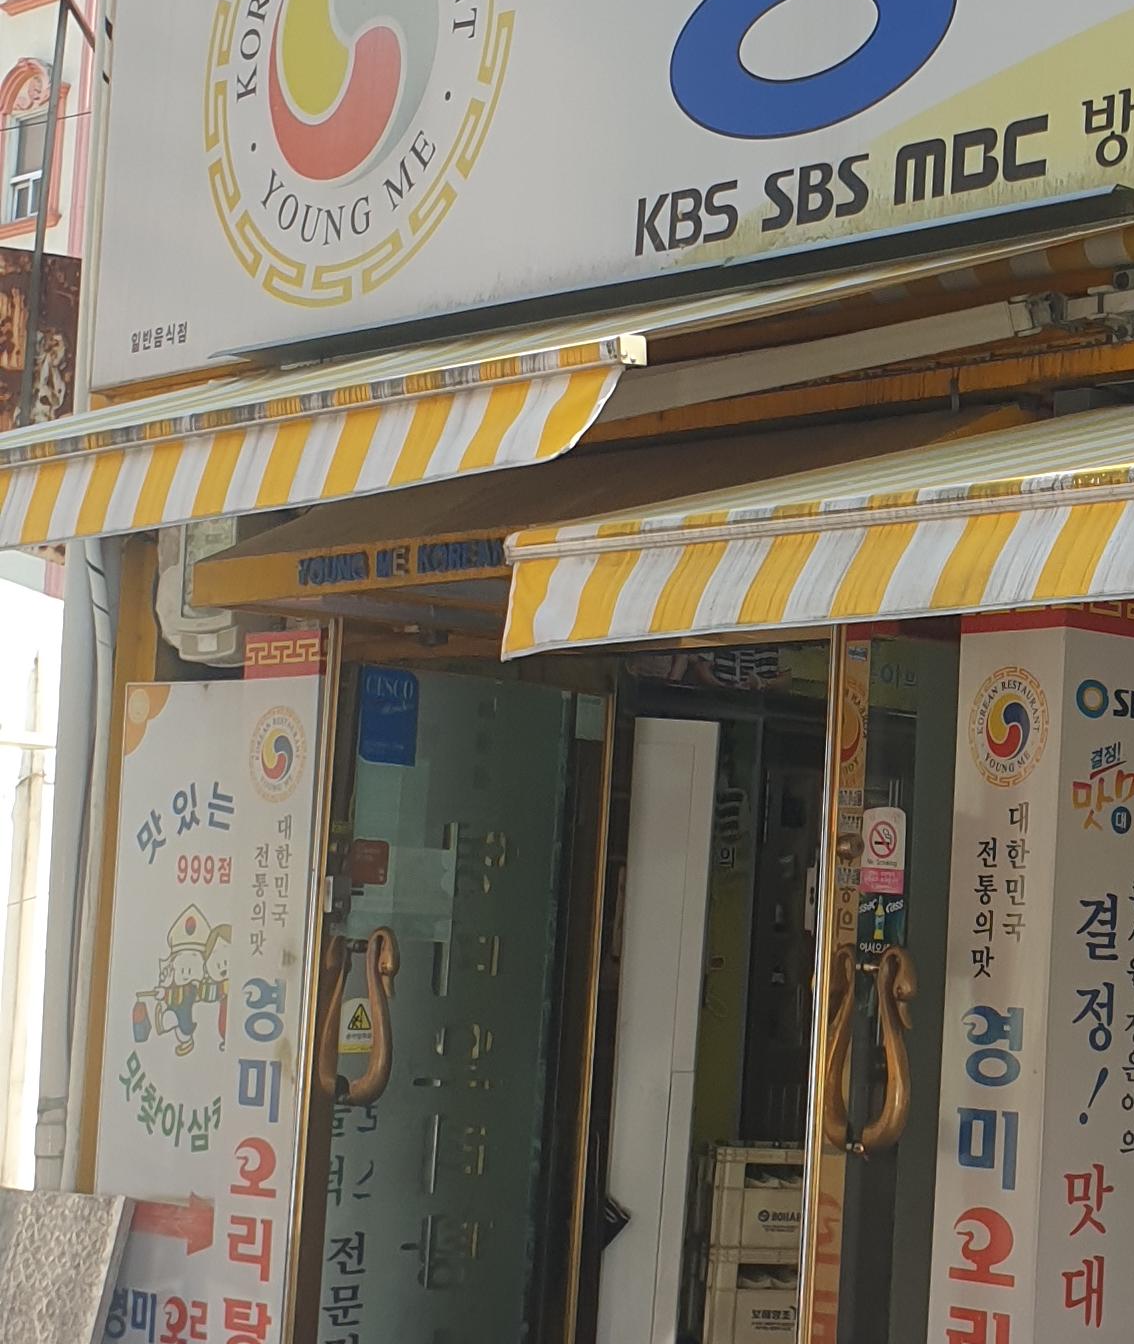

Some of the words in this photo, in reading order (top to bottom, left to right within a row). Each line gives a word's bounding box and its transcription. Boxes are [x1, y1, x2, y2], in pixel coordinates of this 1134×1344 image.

[260, 168, 373, 246] YOUNG
[390, 130, 437, 212] ME
[635, 180, 738, 256] KBS
[761, 153, 870, 232] SBS
[894, 114, 1049, 206] MBC
[131, 321, 188, 353] 일반음식점
[136, 781, 235, 865] 맛있는
[176, 855, 232, 885] 999점
